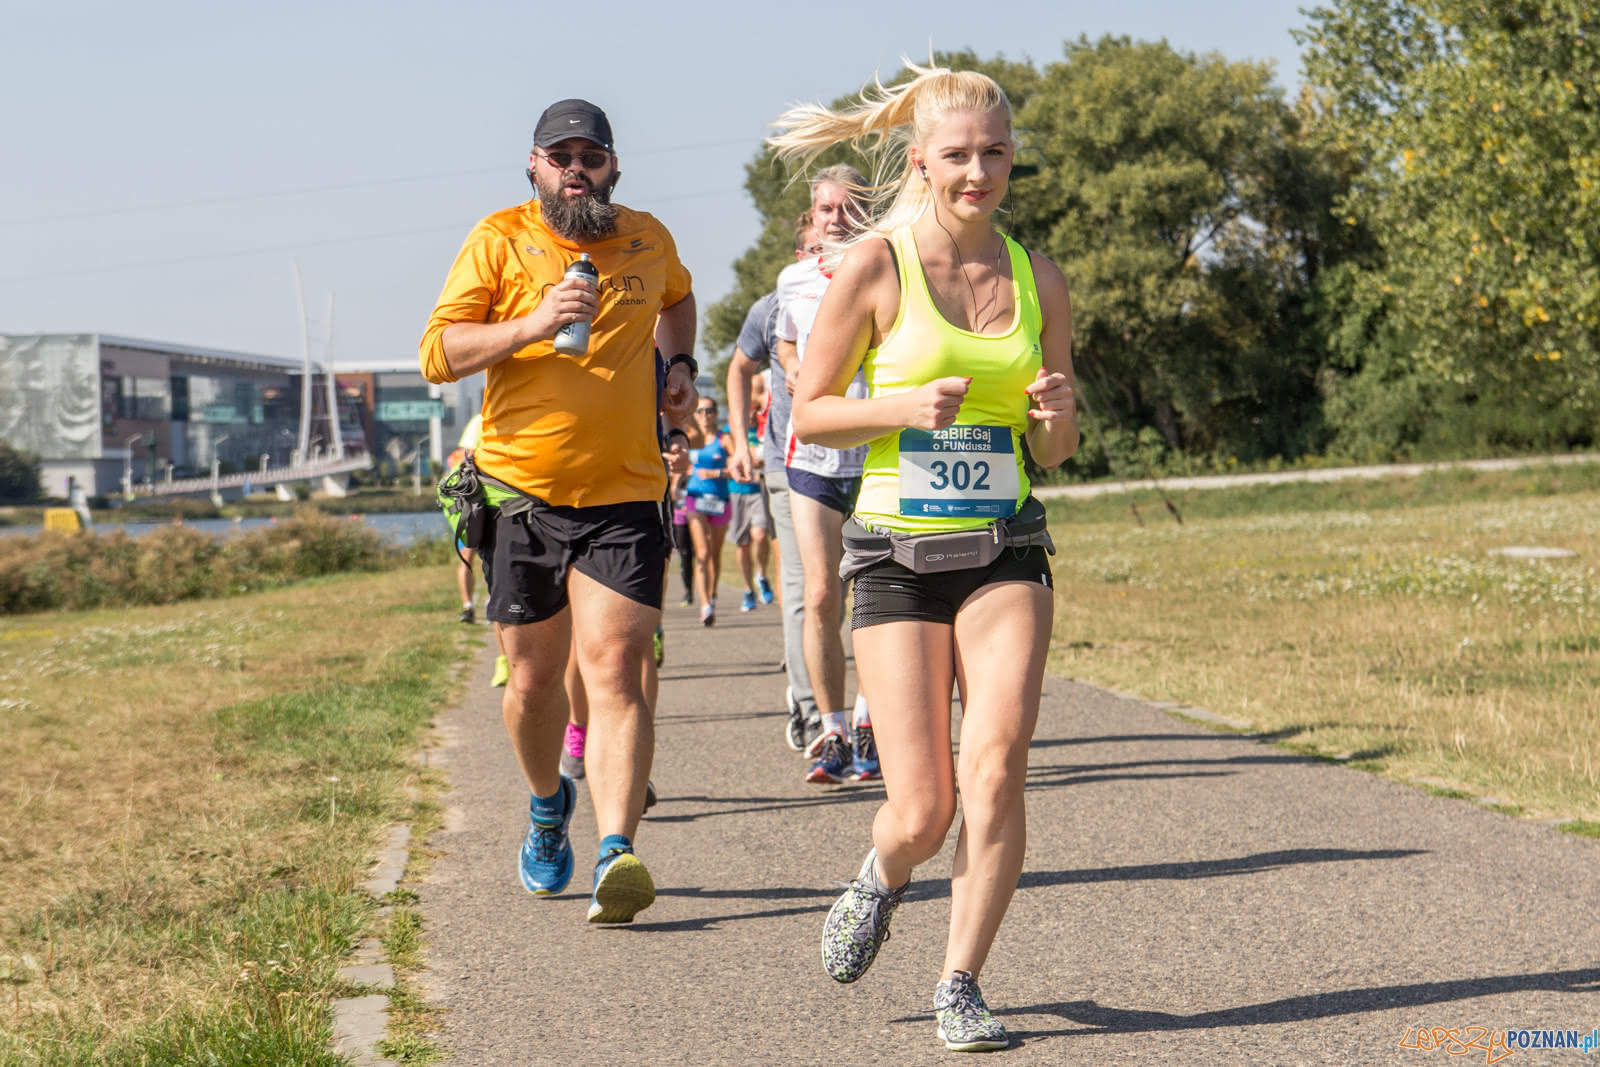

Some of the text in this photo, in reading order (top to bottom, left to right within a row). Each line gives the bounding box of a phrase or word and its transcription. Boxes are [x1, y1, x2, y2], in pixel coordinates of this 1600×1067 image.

[932, 427, 991, 443] zaBIEGaj
[932, 440, 992, 451] o FUNdusze
[929, 460, 991, 491] 302
